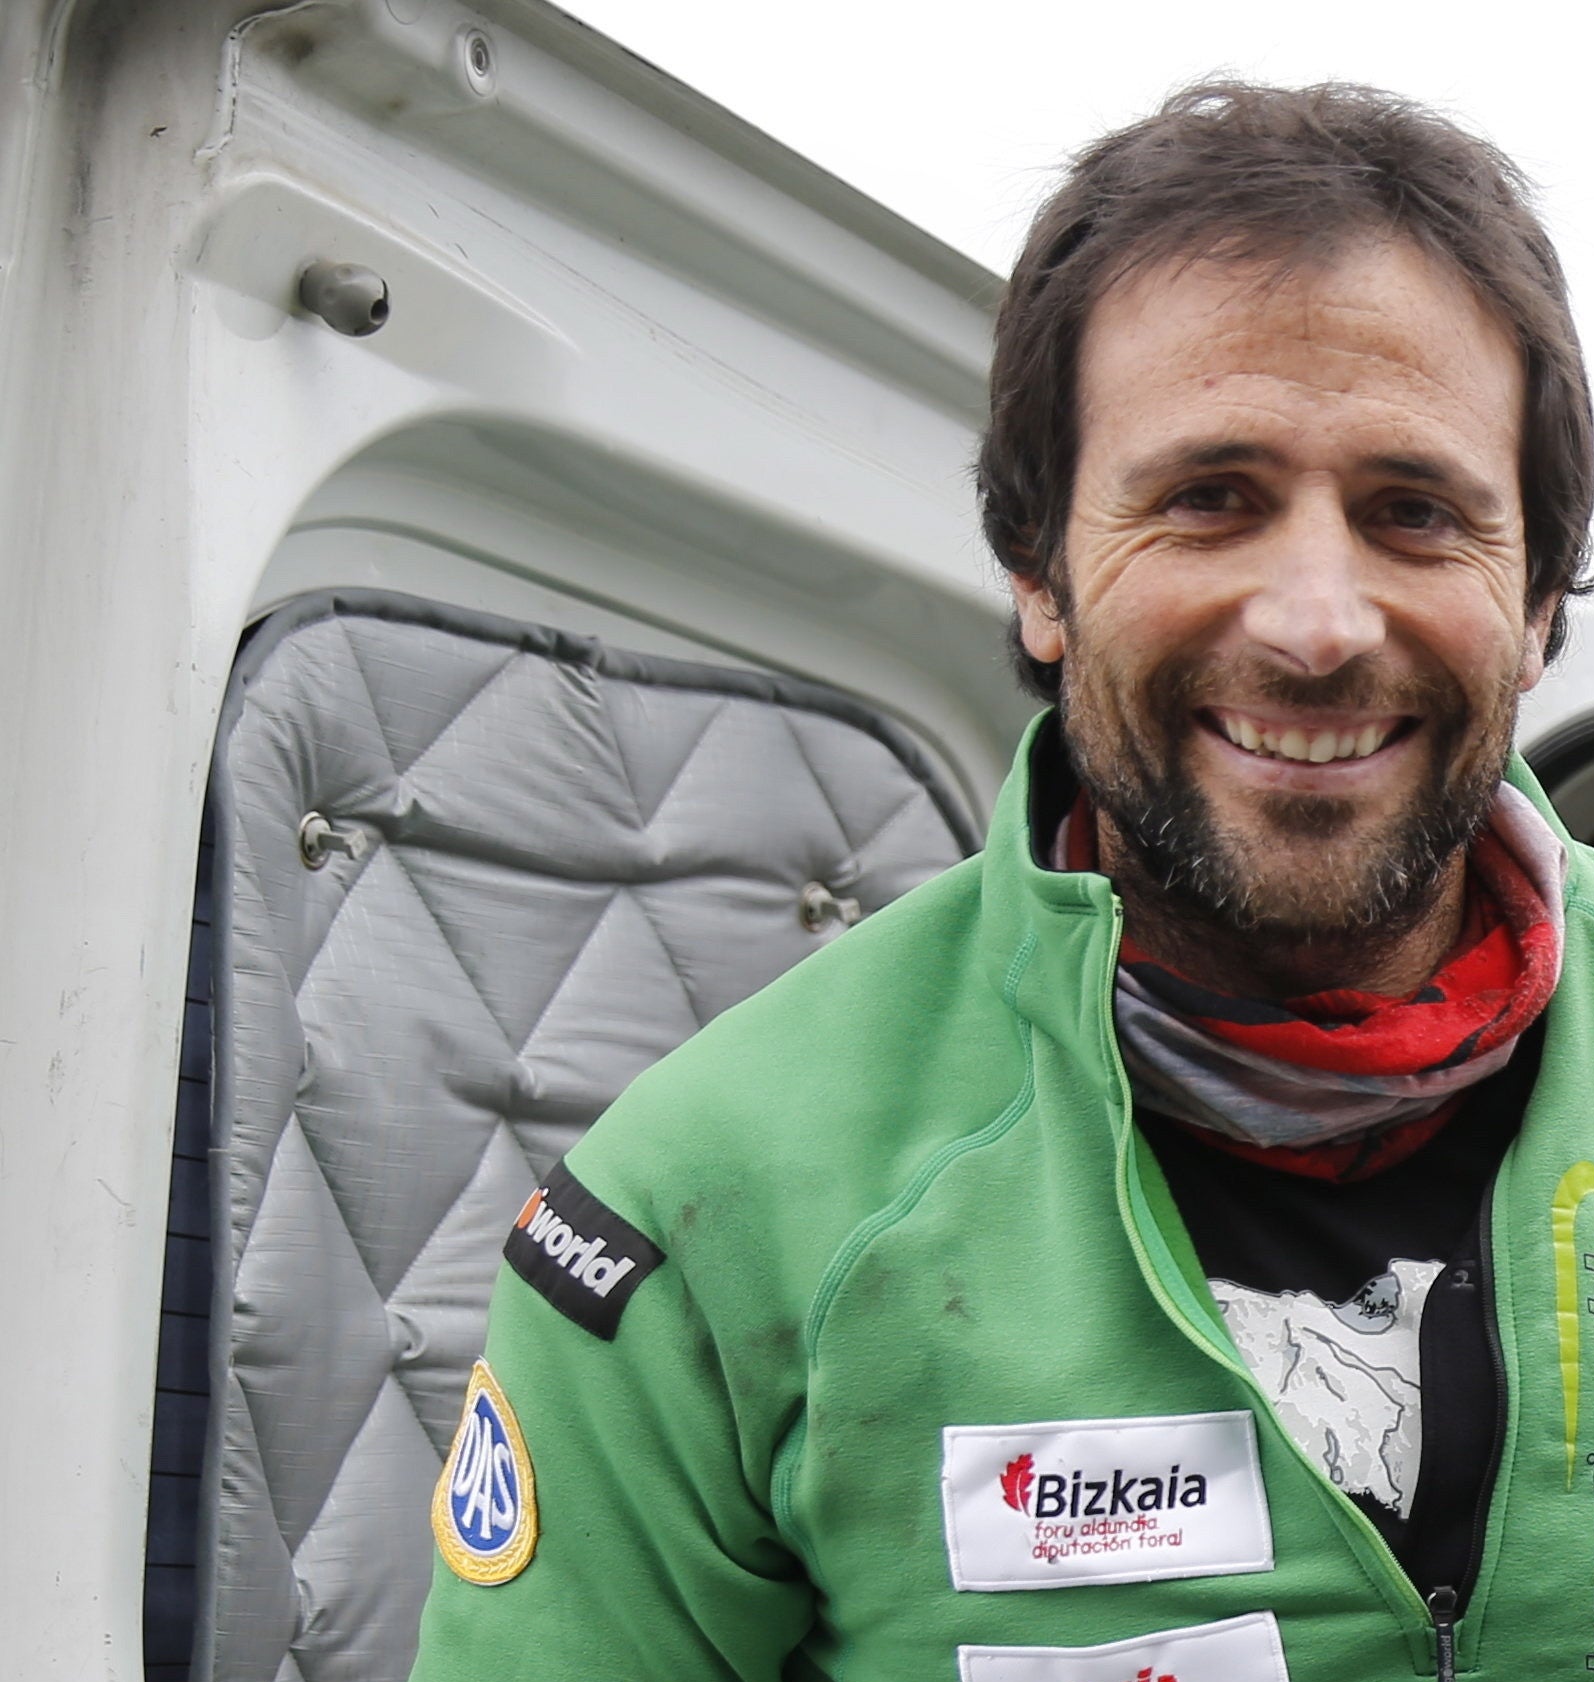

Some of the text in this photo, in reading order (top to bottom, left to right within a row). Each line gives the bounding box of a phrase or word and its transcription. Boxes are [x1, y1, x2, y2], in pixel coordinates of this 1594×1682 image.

[1034, 1464, 1207, 1519] Bizkaia
[1032, 1528, 1183, 1562] diputación foral
[1034, 1520, 1075, 1540] foru
